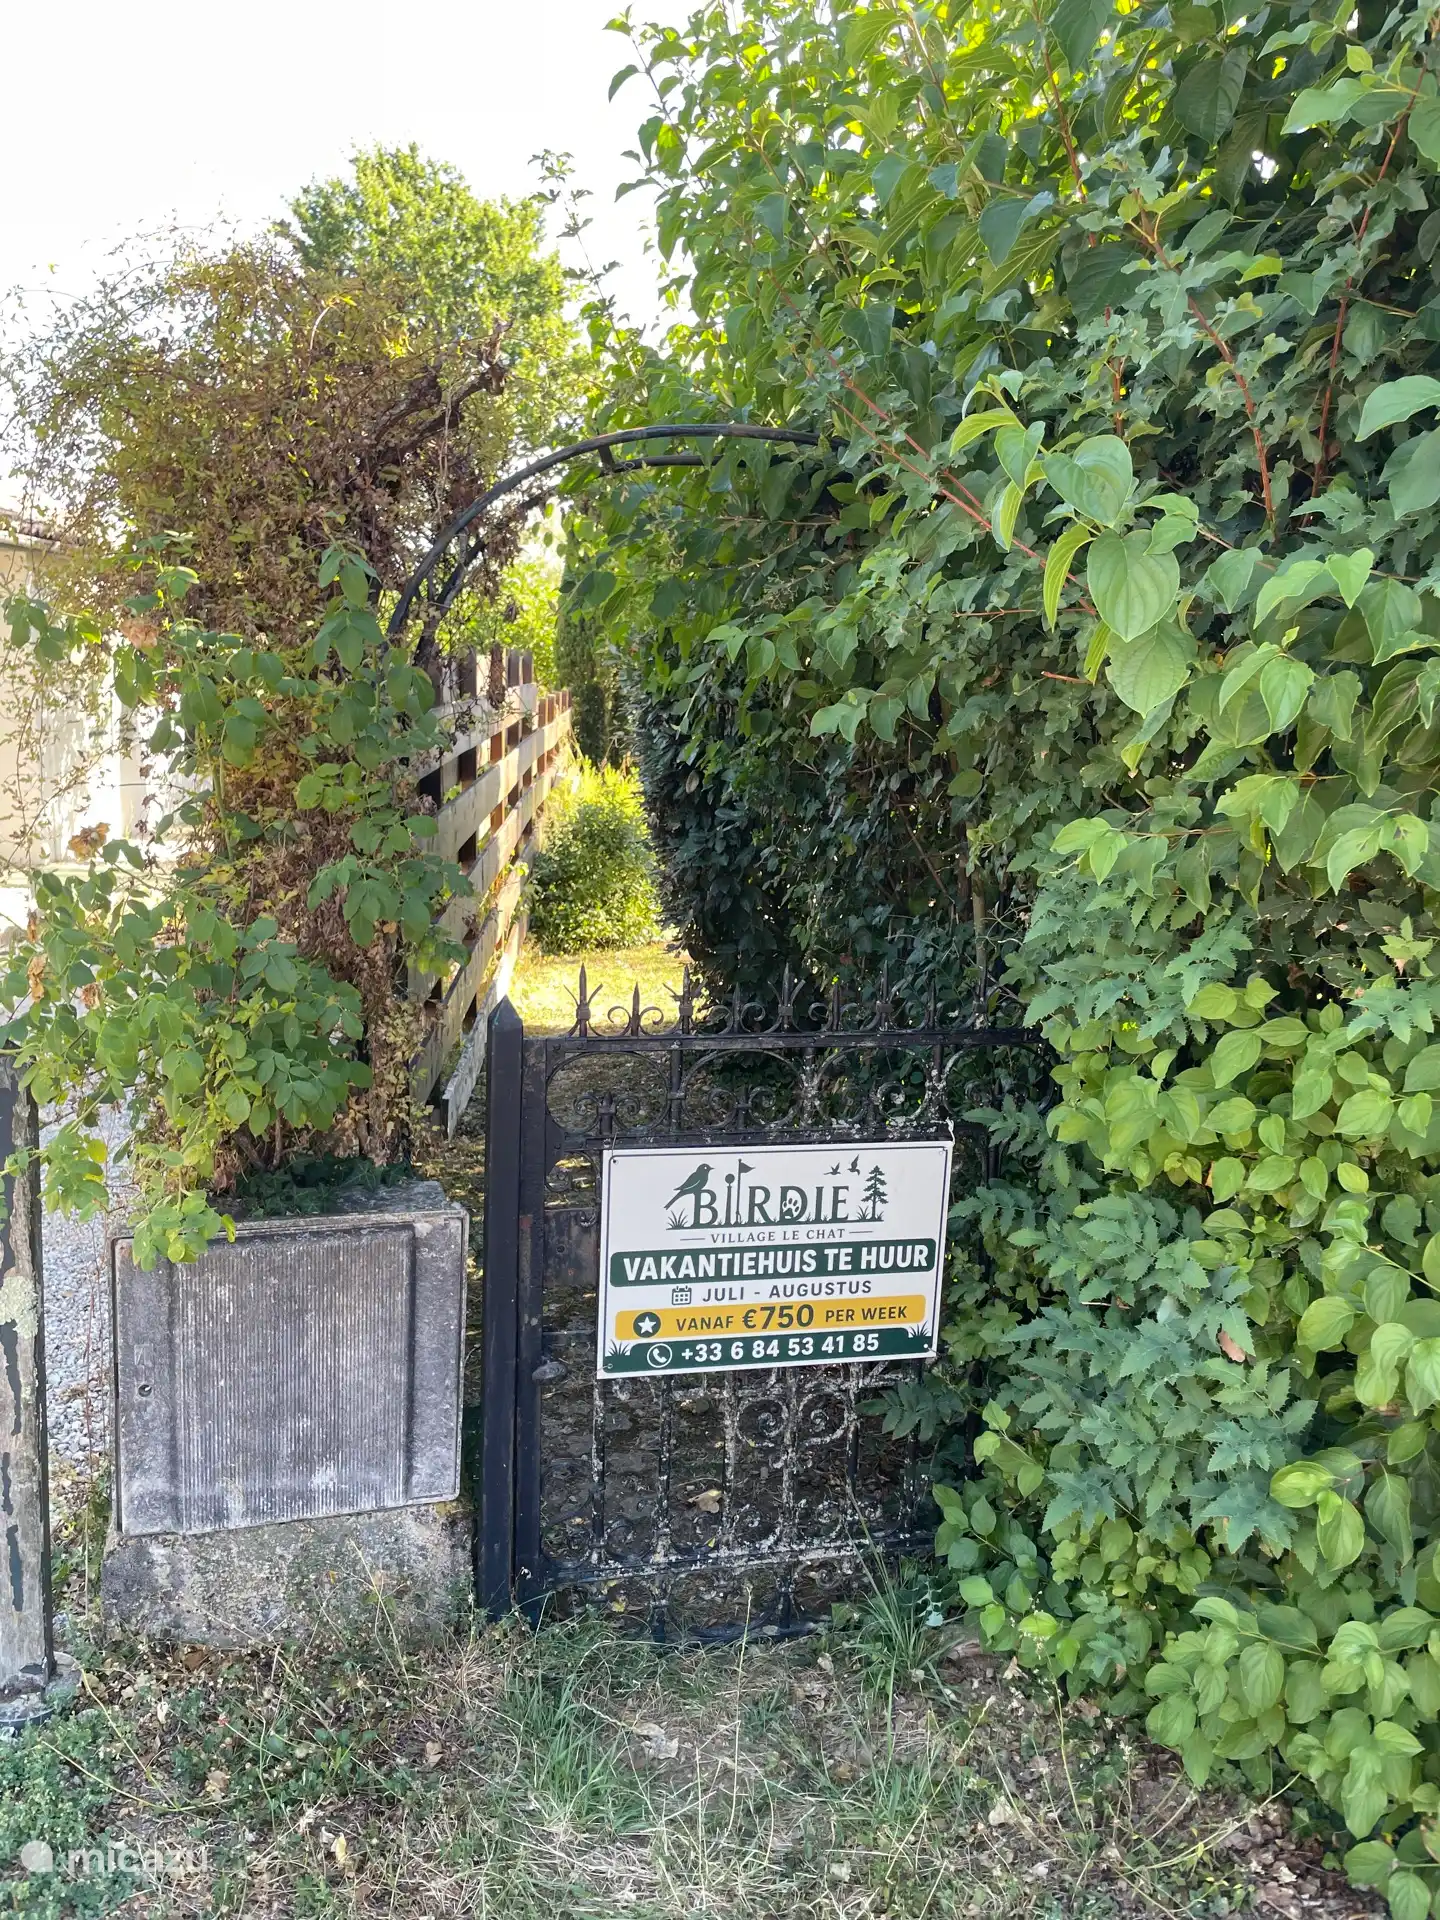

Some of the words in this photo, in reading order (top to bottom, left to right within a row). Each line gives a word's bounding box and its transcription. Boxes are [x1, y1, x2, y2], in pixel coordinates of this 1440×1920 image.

[710, 1231, 776, 1244] VILLAGE
[782, 1230, 801, 1241] LE
[806, 1228, 846, 1240] CHAT
[623, 1249, 817, 1282] VAKANTIEHUIS
[824, 1249, 852, 1272] TE
[860, 1245, 929, 1269] HUUR
[702, 1286, 745, 1302] JULI
[769, 1280, 872, 1298] AUGUSTUS
[676, 1315, 734, 1331] VANAF
[742, 1304, 814, 1330] €750
[825, 1309, 855, 1322] PER
[862, 1305, 908, 1320] WEEK
[681, 1343, 722, 1362] +33
[730, 1342, 744, 1360] 6
[752, 1340, 779, 1359] 84
[787, 1338, 813, 1357] 53
[821, 1336, 844, 1354] 41
[853, 1333, 879, 1352] 85
